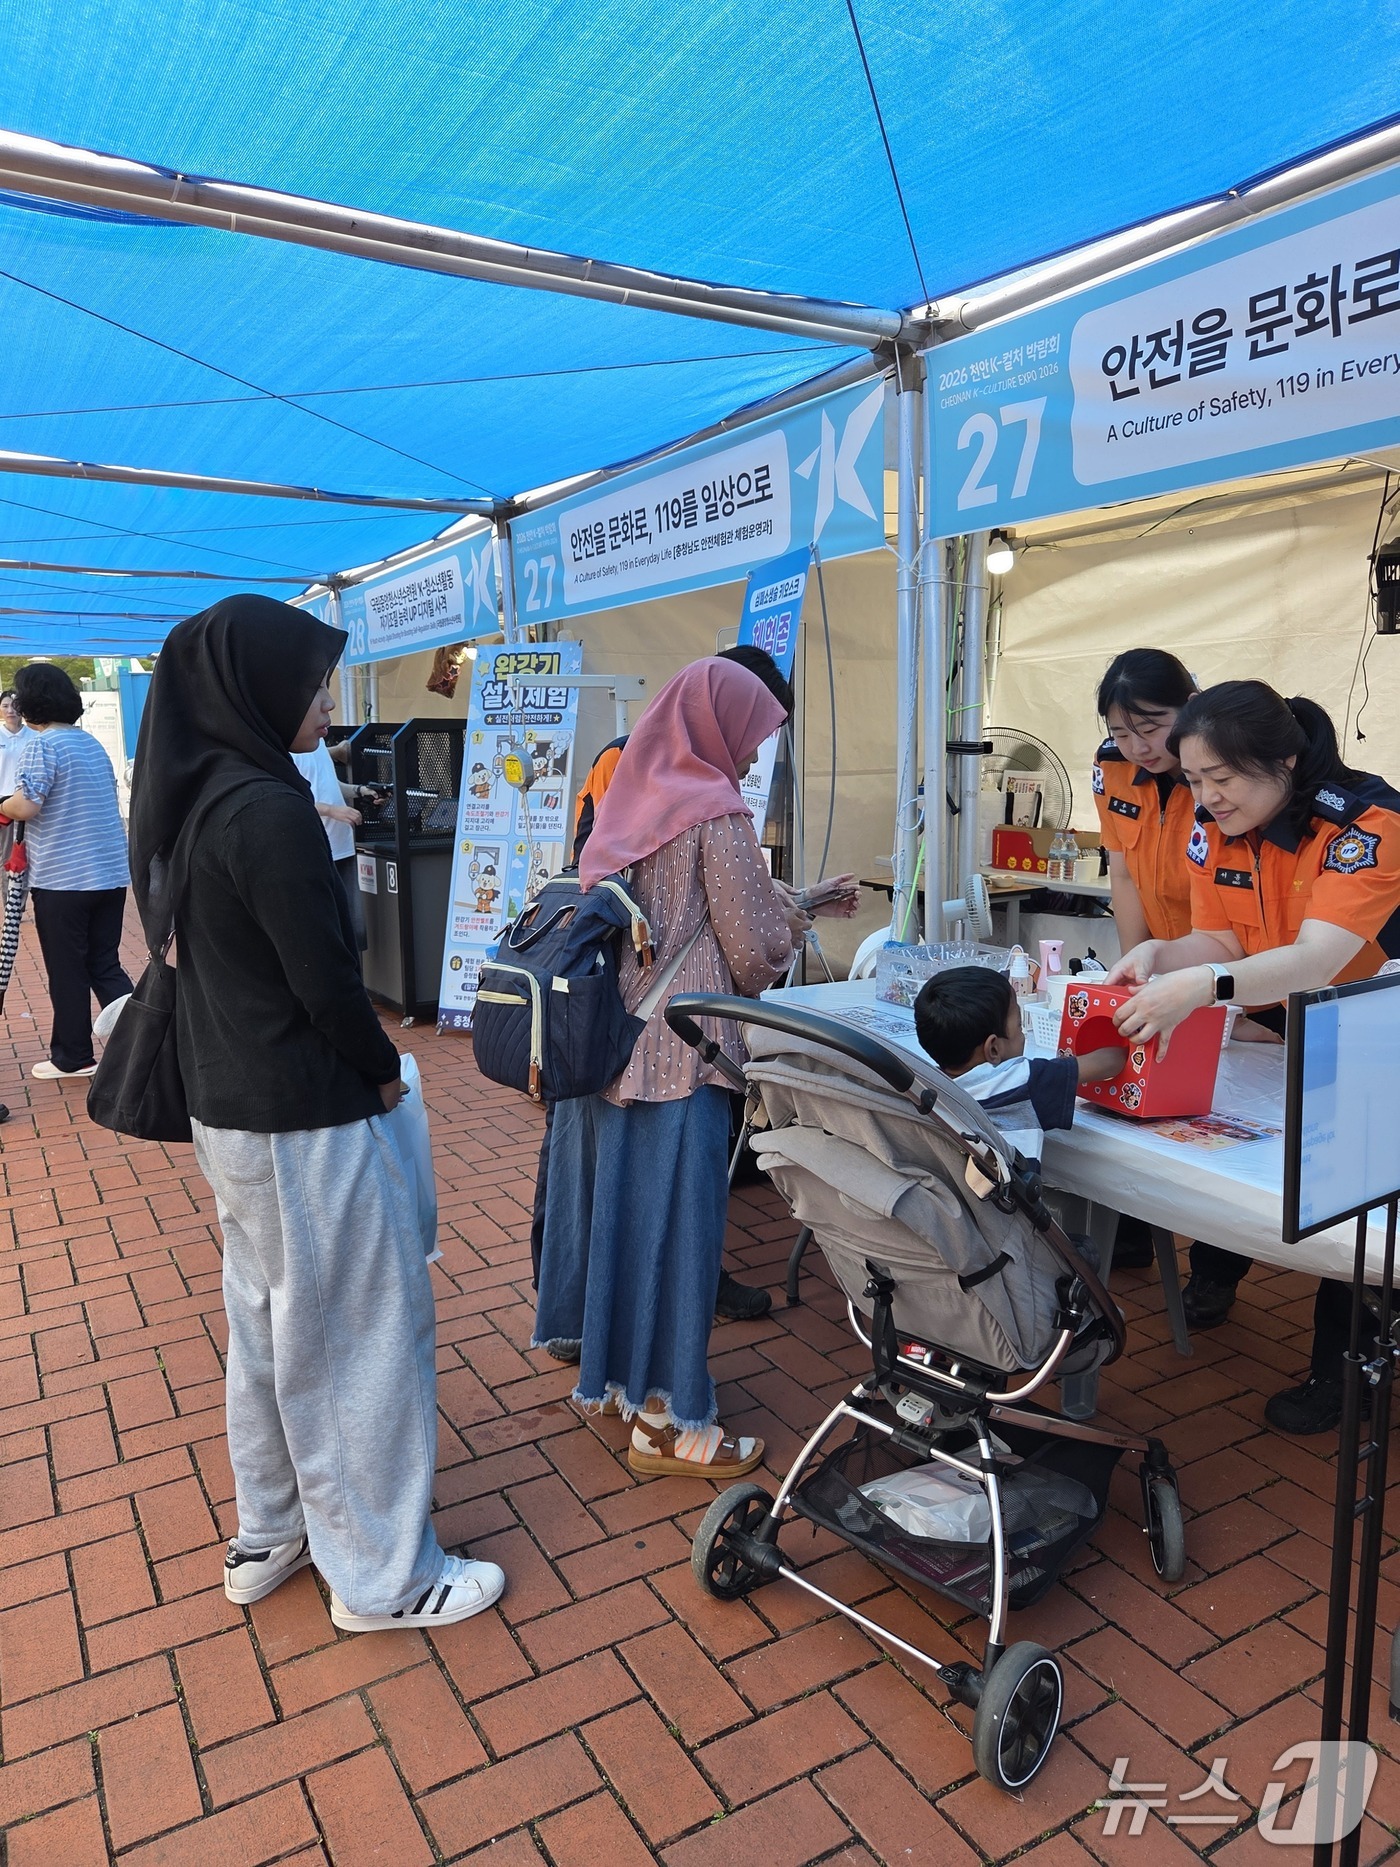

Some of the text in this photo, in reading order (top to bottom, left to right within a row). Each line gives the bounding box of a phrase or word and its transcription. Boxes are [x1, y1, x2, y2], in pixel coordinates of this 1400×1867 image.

[939, 367, 968, 391] 2026
[1026, 333, 1060, 361] 박람회
[1101, 307, 1233, 402] 안전을
[940, 362, 1059, 409] CHEONAN K-CULTURE EXPO 2026
[1106, 424, 1118, 442] A
[1121, 411, 1183, 437] Culture
[1187, 401, 1205, 423] of
[1209, 388, 1272, 417] Safety,
[1276, 372, 1310, 398] 119
[1316, 368, 1334, 388] in
[957, 396, 1047, 511] 27
[570, 521, 606, 562] 안전을
[608, 507, 653, 551] 문화로,
[654, 488, 699, 533] 119를
[701, 464, 774, 523] 일상으로
[574, 519, 773, 584] A Culture of Safety, 119 in Everyday Life [충청남도 안전체험관 체험운영과]
[523, 555, 556, 613] 27
[778, 578, 800, 600] 키오스크
[408, 605, 417, 622] UP
[417, 598, 435, 620] 디지털
[435, 593, 448, 615] 사격
[348, 618, 365, 657] 28
[493, 652, 561, 681] 완강기
[527, 732, 533, 742] 2
[463, 843, 470, 851] 3
[517, 843, 524, 853] 4
[1341, 846, 1358, 855] 119
[389, 867, 396, 888] 8
[453, 1014, 473, 1029] 충청
